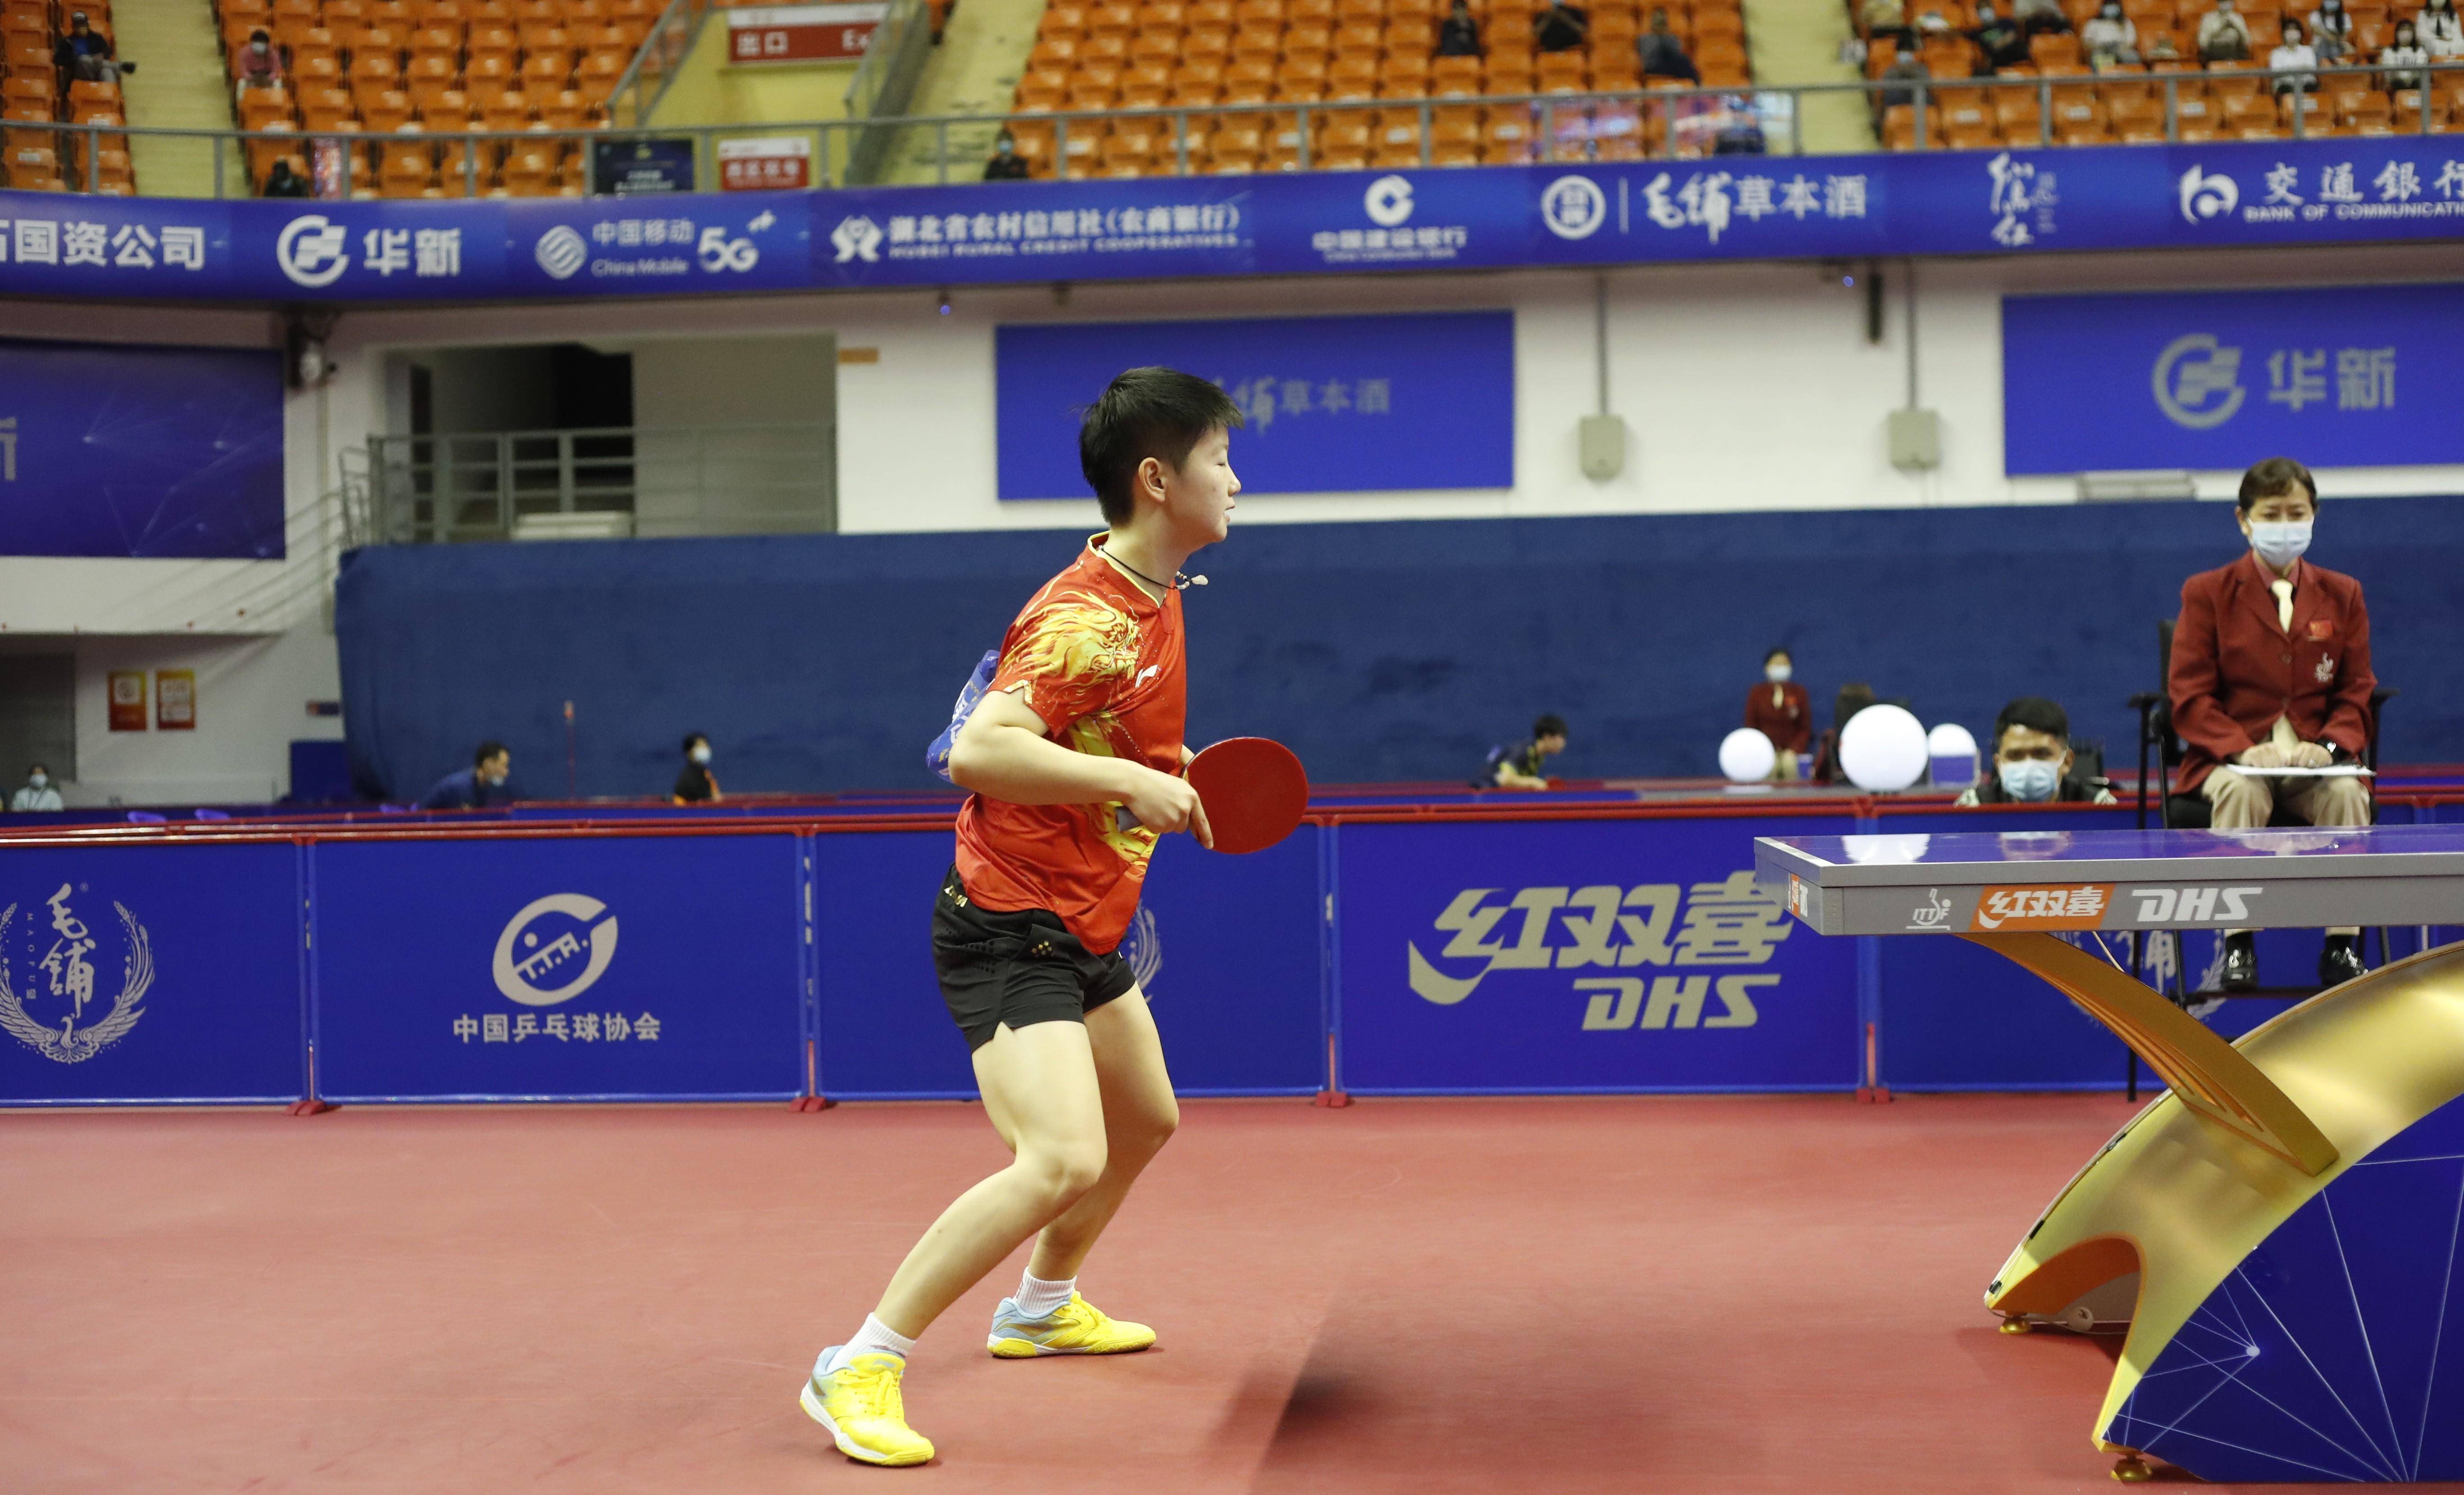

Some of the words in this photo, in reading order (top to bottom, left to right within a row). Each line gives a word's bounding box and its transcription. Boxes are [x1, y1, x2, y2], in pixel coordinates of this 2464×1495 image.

[737, 31, 789, 57] 出口
[592, 218, 695, 247] 中国移动
[2243, 205, 2295, 223] BANK
[2301, 204, 2329, 222] OF
[0, 219, 204, 271] 国资公司
[363, 227, 462, 277] 华新
[2266, 347, 2396, 411] 华新
[1214, 376, 1391, 435] 铺草本酒
[1979, 886, 2106, 929] 红双喜
[2132, 887, 2263, 922] DHS
[1409, 870, 1795, 1005] 红双喜
[1572, 974, 1781, 1030] DHS
[453, 1012, 661, 1043] 中国乒乓球协会
